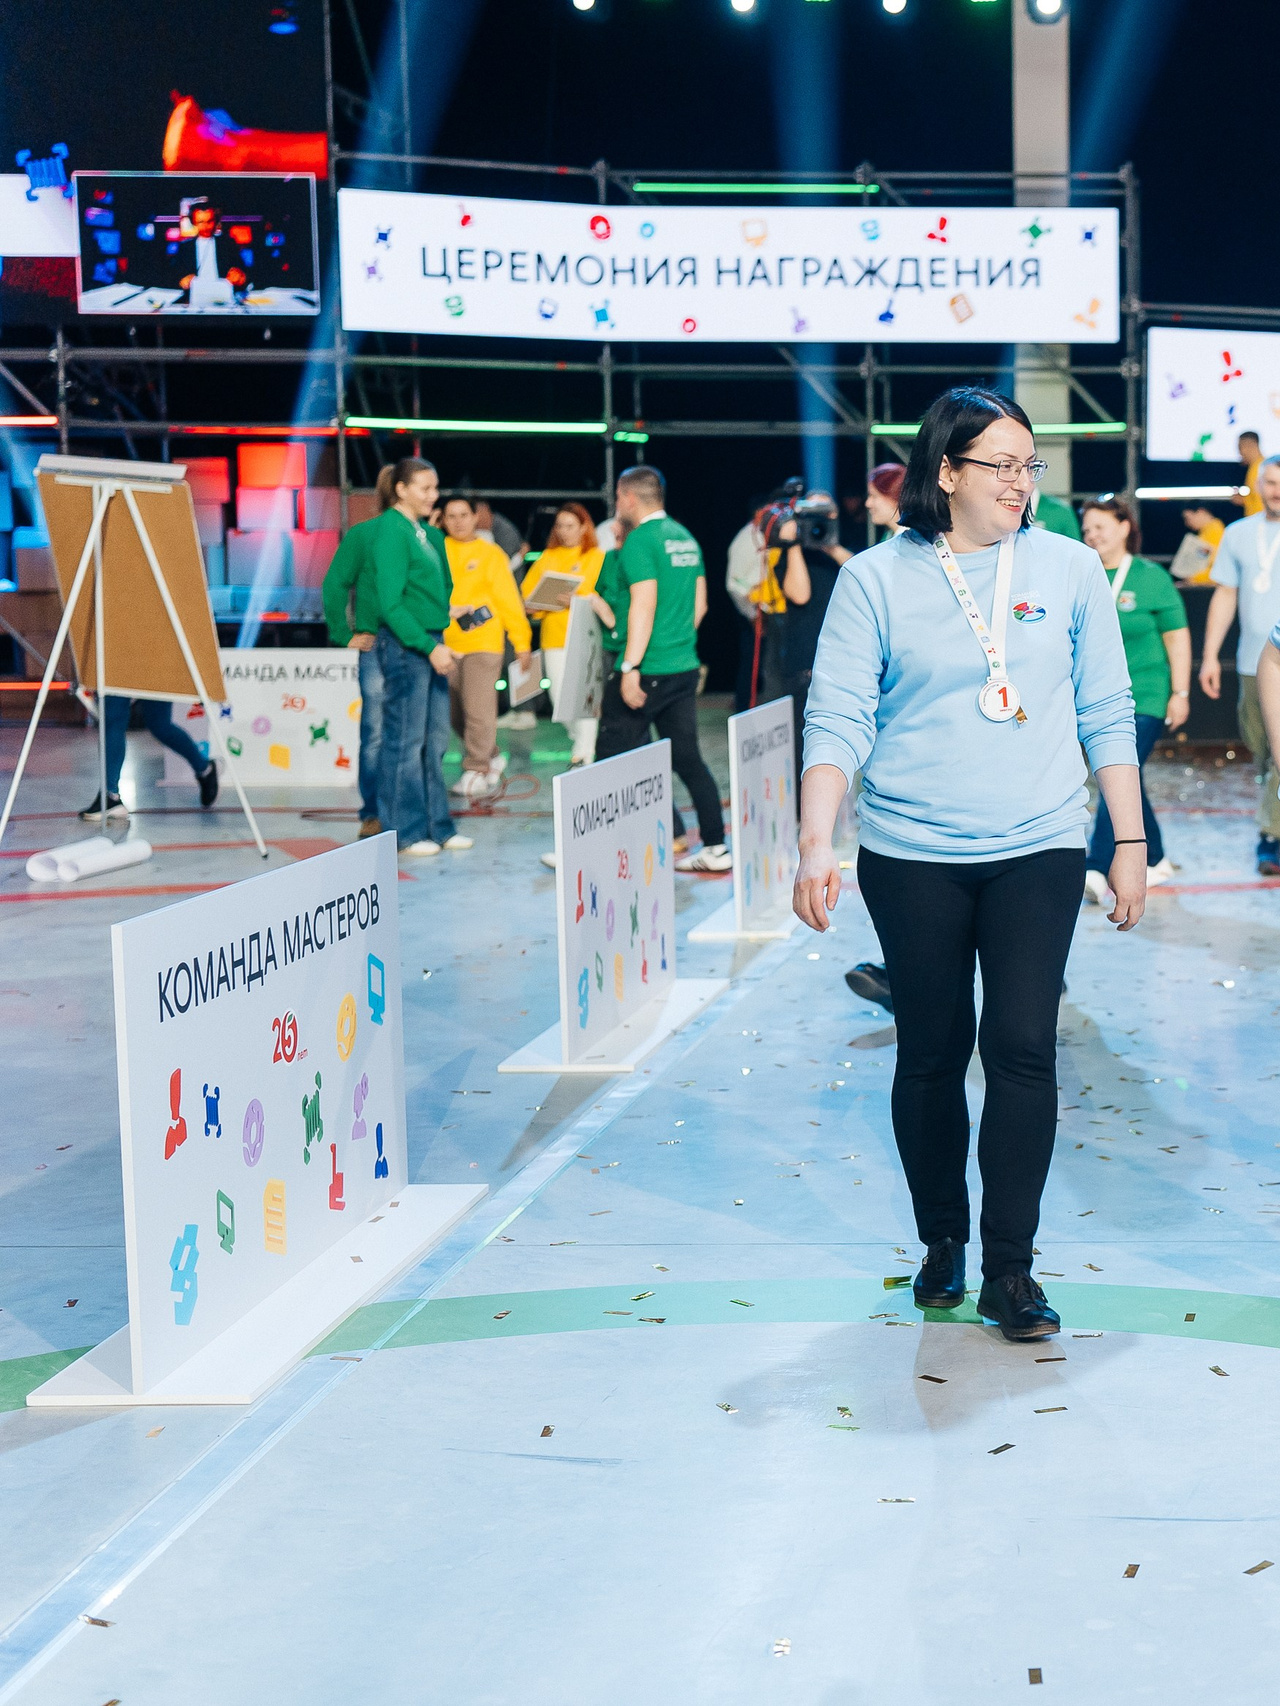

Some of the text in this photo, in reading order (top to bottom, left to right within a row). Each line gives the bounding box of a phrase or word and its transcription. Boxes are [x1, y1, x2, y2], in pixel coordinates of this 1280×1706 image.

[420, 246, 1042, 293] ЦЕРЕМОНИЯ НАГРАЖДЕНИЯ
[997, 686, 1009, 708] 1
[572, 773, 663, 839] КОМАНДА МАСТЕРОВ
[157, 883, 380, 1023] КОМАНДА МАСТЕРОВ
